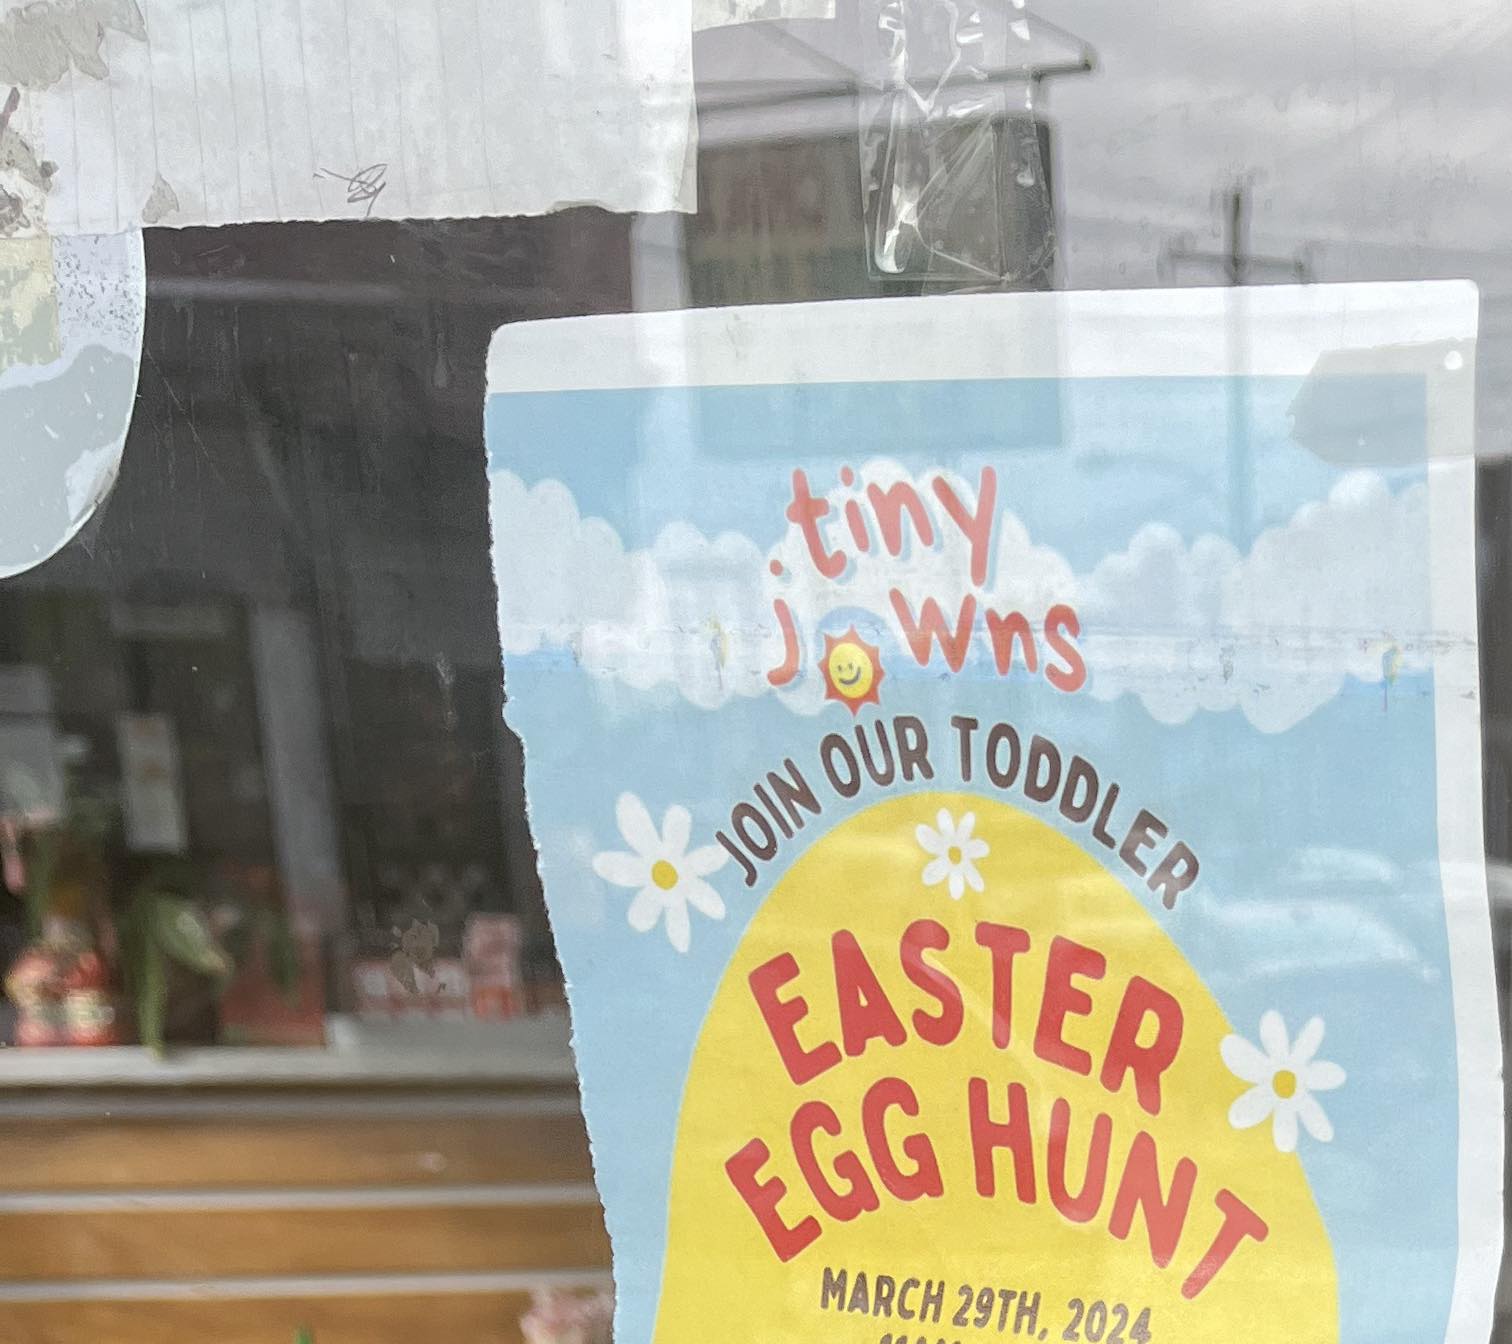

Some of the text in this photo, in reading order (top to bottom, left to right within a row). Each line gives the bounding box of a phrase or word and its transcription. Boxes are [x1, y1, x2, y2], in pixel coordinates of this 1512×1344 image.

[787, 466, 996, 587] tiny
[714, 715, 1201, 910] JOIN OUR TODDLER
[748, 919, 1184, 1116] EASTER
[724, 1077, 1269, 1300] EGG HUNT
[820, 1266, 945, 1324] MARCH
[952, 1287, 1049, 1342] 29TH,
